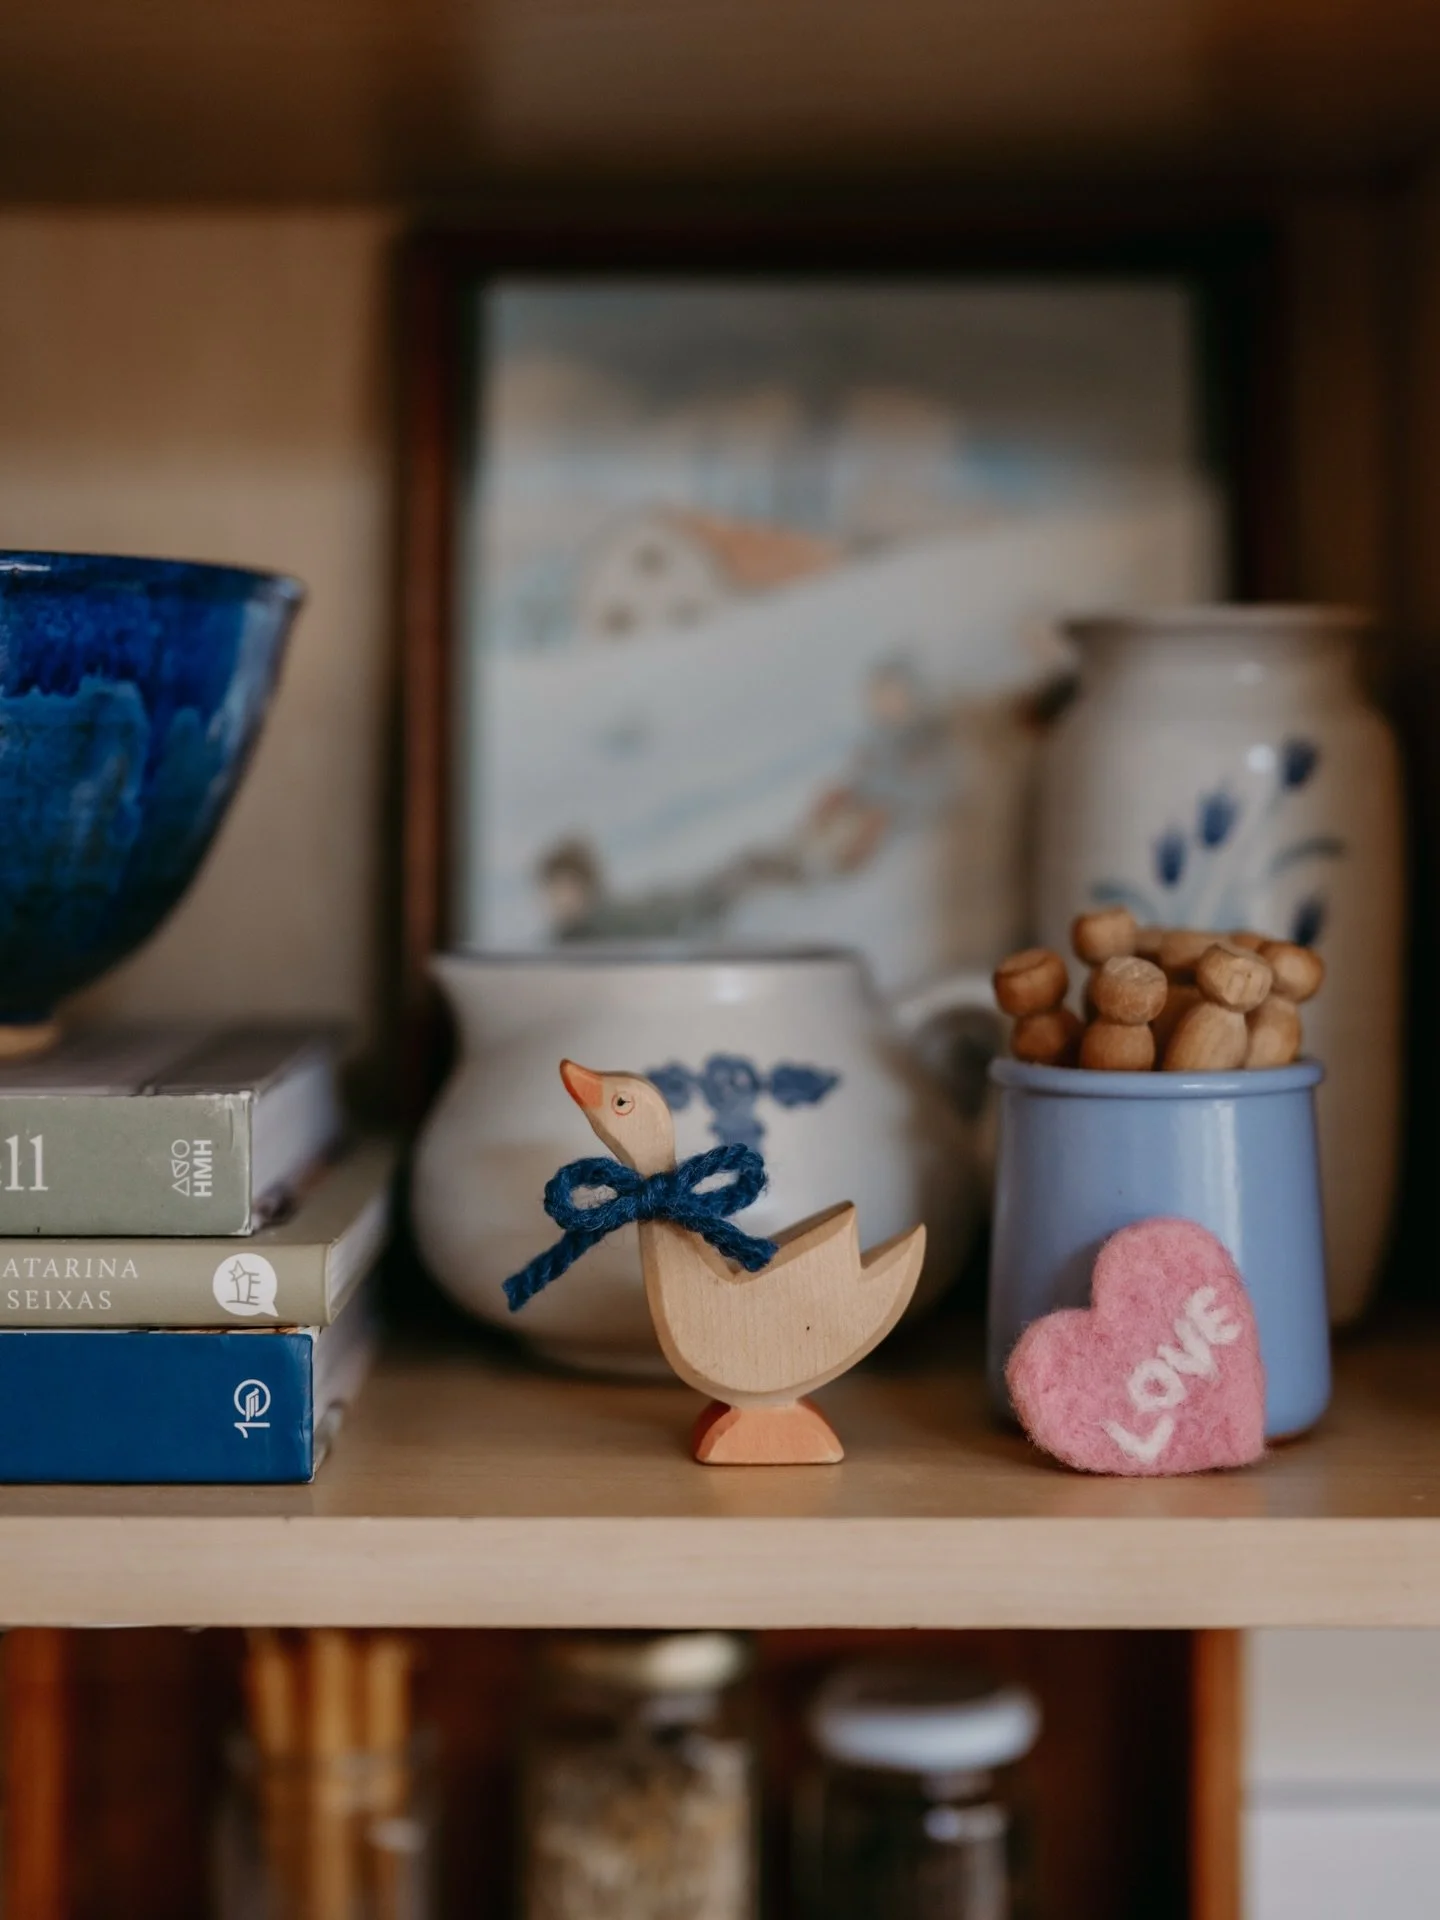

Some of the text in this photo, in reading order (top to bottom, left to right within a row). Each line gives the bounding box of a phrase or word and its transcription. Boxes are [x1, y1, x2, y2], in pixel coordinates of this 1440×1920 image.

[0, 1134, 49, 1191] ll
[193, 1139, 213, 1197] HMH
[7, 1289, 112, 1310] SEIXAS
[1101, 1285, 1242, 1463] LOVE
